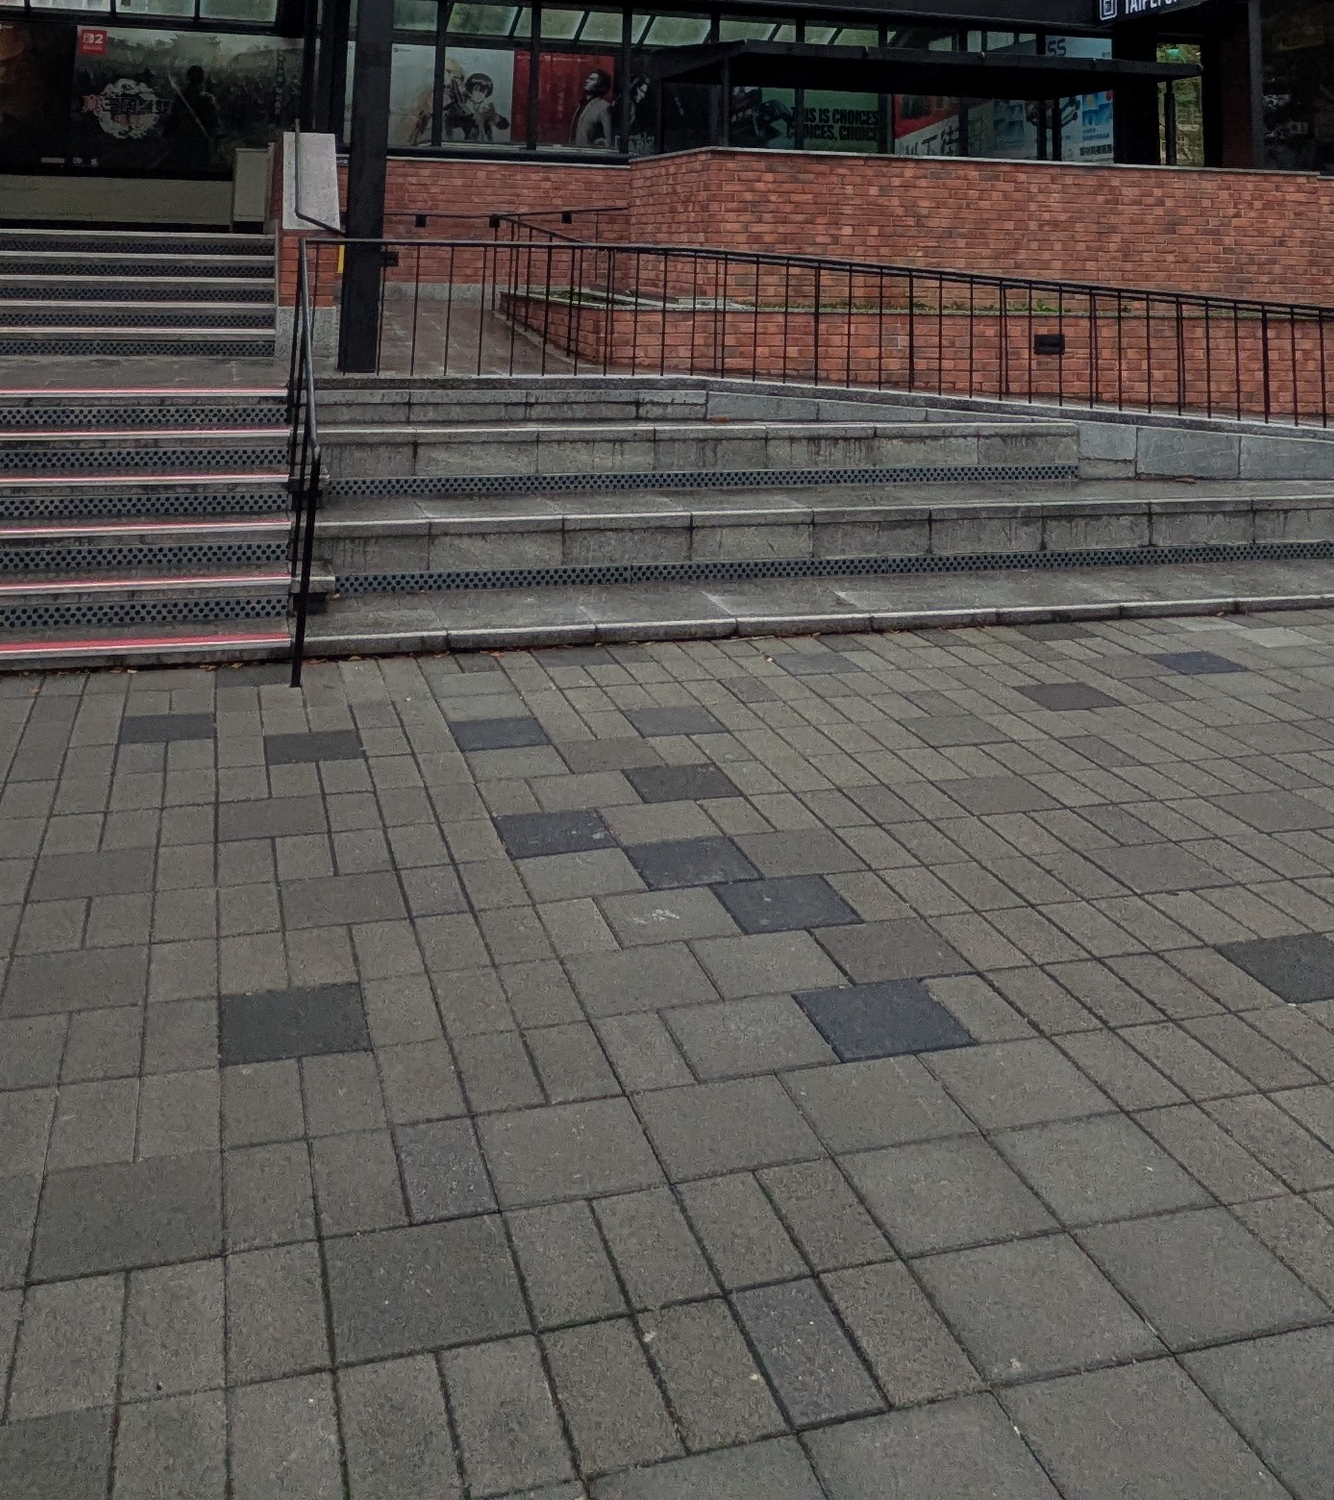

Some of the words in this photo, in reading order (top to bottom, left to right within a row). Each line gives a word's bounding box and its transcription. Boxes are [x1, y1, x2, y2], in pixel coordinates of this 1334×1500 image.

[791, 106, 816, 124] TIS
[818, 107, 830, 124] IS
[786, 121, 837, 141] COICES,
